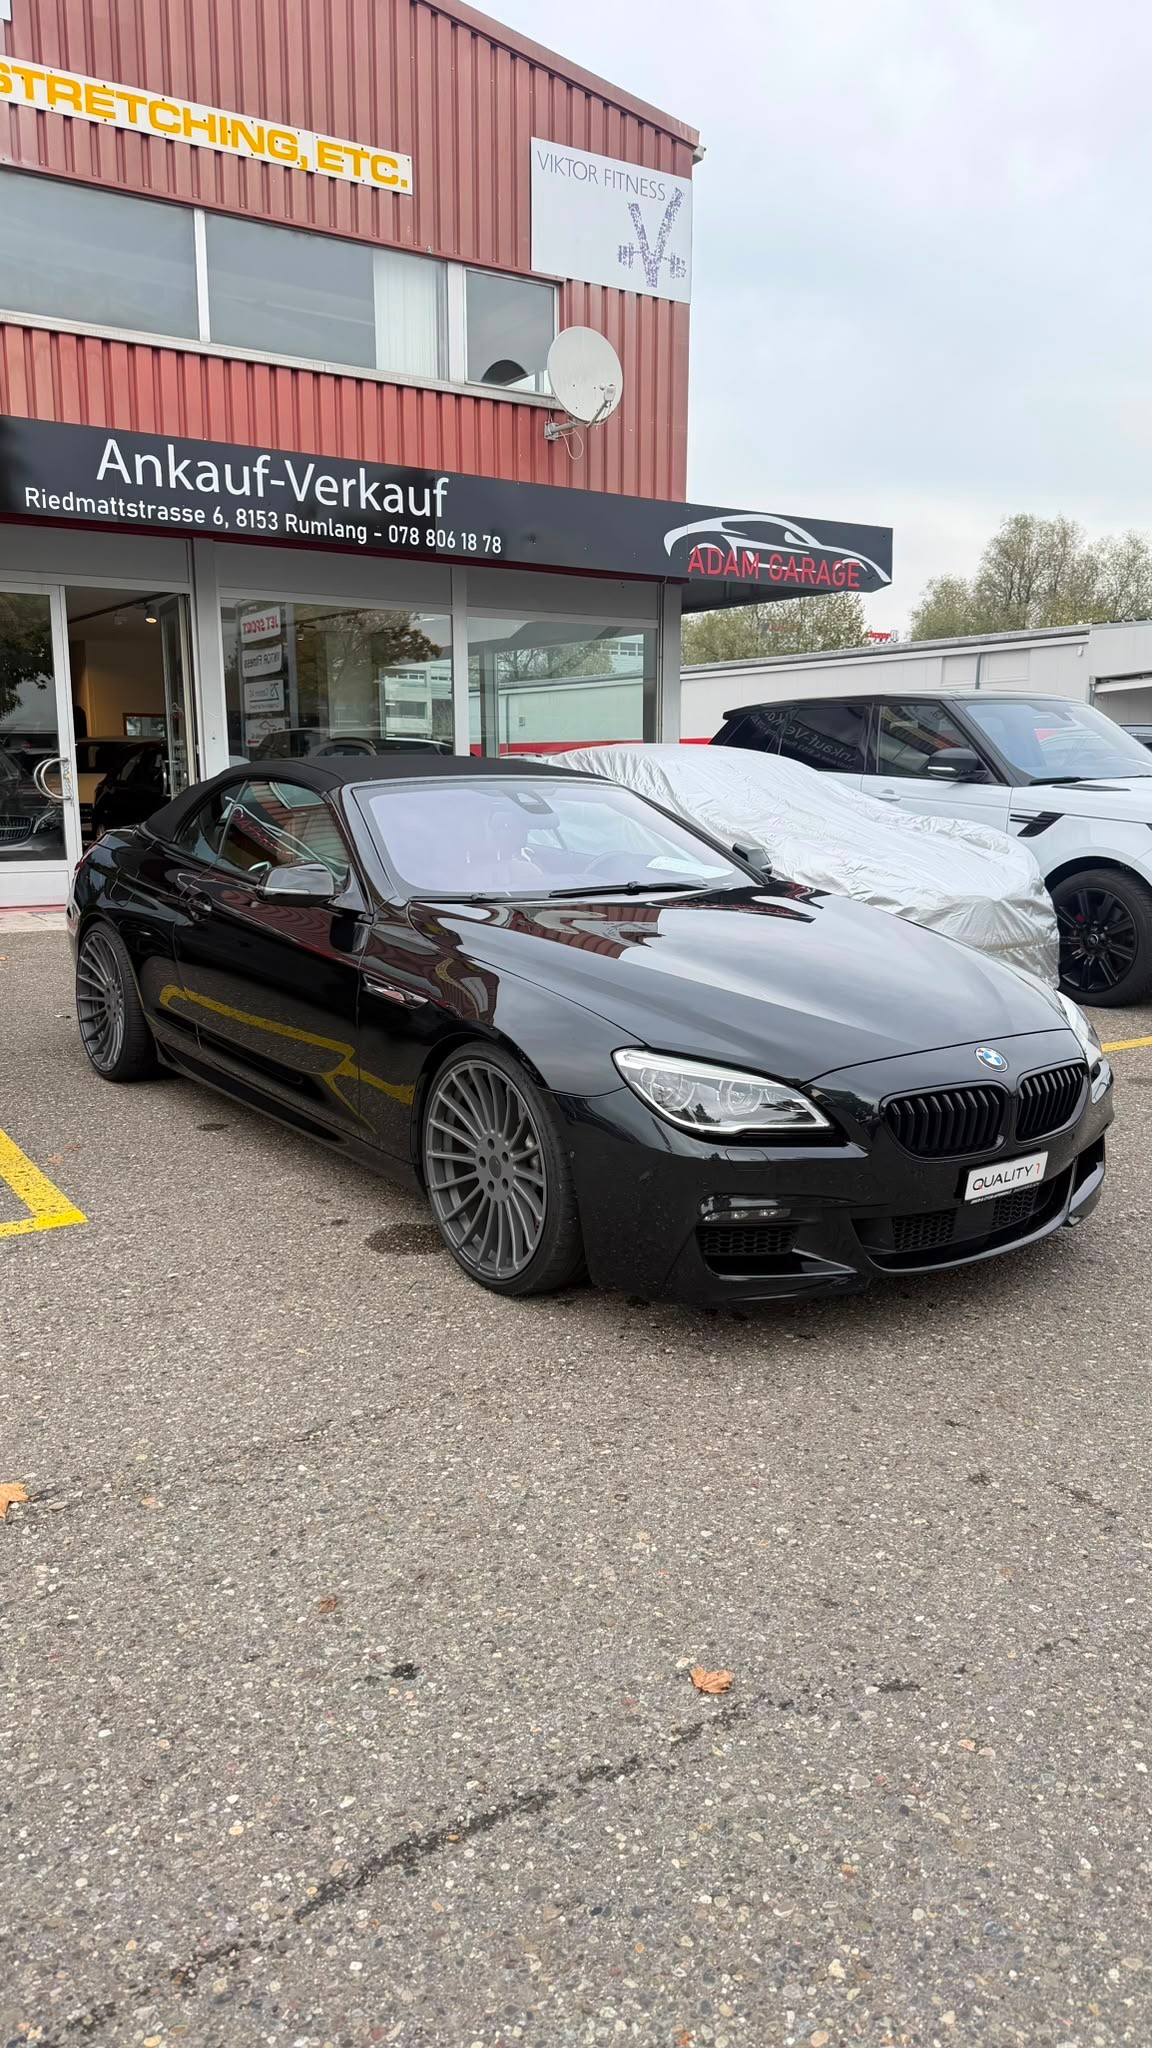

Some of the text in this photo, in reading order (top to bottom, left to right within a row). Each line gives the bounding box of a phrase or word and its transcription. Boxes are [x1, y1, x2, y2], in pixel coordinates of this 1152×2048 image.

[317, 140, 409, 187] ETC.
[537, 150, 666, 202] VIKTOR FITNESS
[96, 438, 449, 518] Ankauf-Verkauf
[24, 486, 206, 524] Riedmattstrasse
[212, 505, 230, 529] 6,
[236, 507, 279, 531] 8153
[285, 513, 368, 544] Rumlang
[388, 524, 420, 546] 078
[425, 528, 456, 550] 806
[460, 532, 477, 551] 18
[482, 535, 502, 554] 78
[687, 546, 861, 588] ADAM GARAGE
[972, 1163, 1034, 1191] QUALITY
